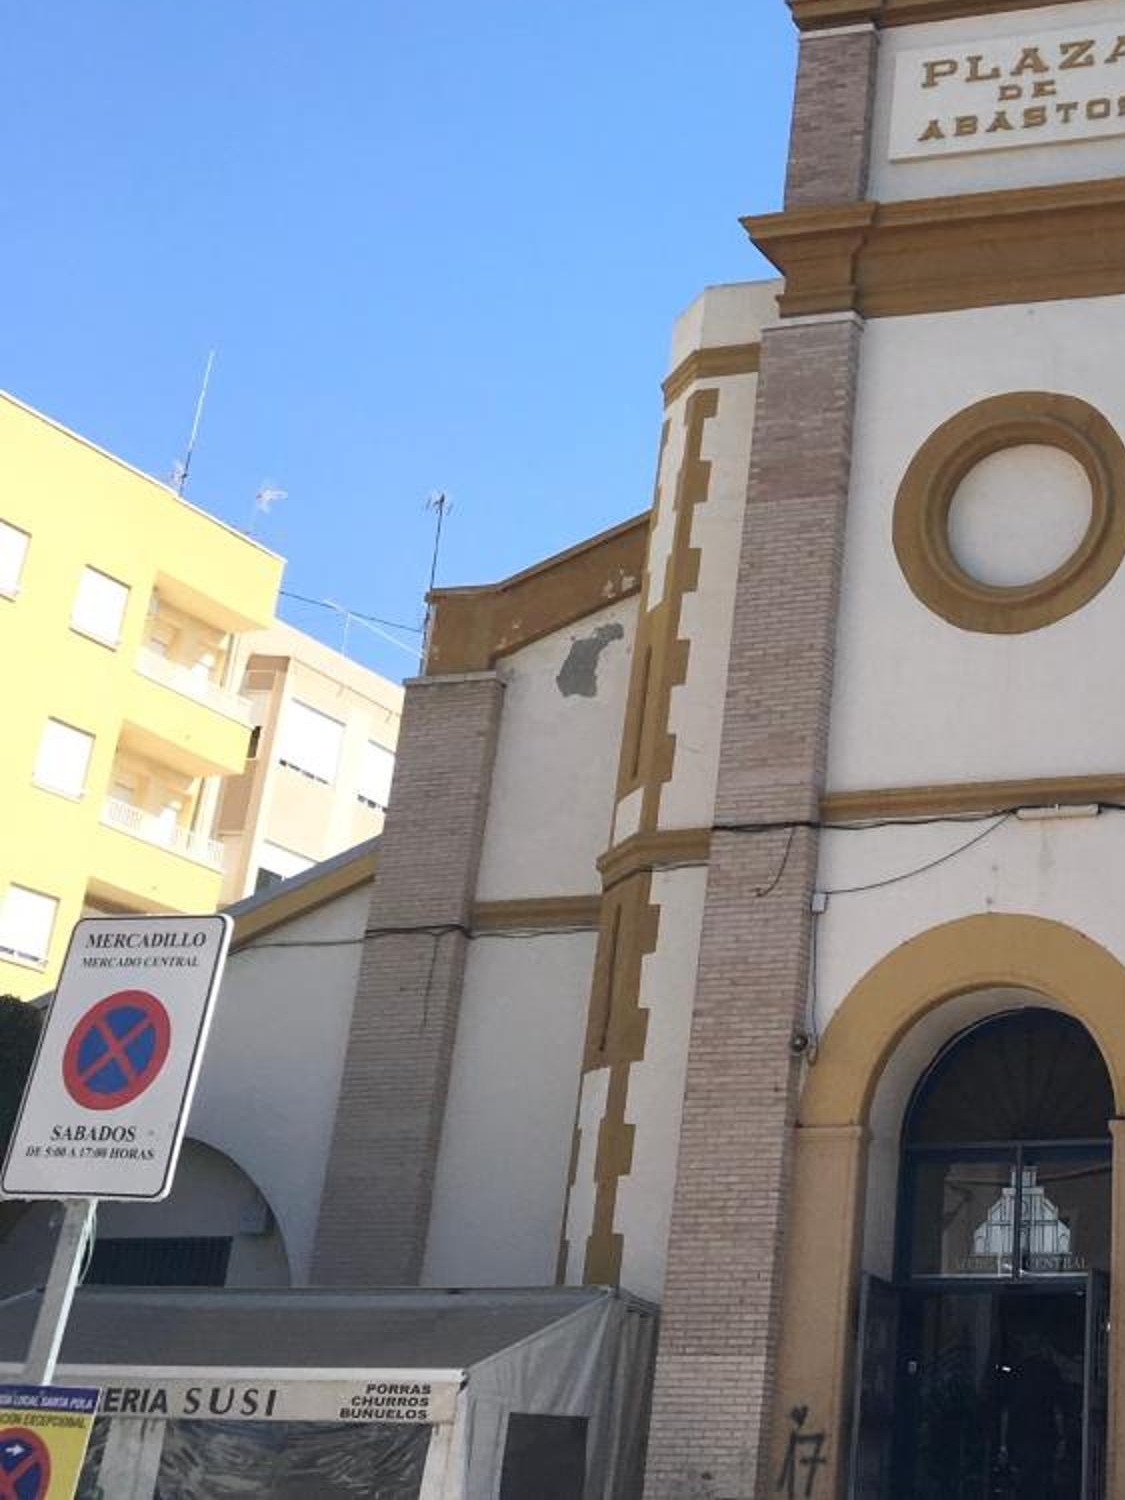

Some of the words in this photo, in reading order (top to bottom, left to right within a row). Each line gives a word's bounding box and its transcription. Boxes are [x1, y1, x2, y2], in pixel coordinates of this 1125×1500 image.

[998, 80, 1057, 101] DE
[86, 932, 206, 948] MERCADILLO
[82, 956, 142, 968] MERCADO
[143, 956, 199, 967] CENTRAL
[50, 1125, 136, 1141] SABADOS
[26, 1146, 40, 1157] DE
[109, 1148, 155, 1159] HORAS
[366, 1384, 431, 1394] PORRAS
[98, 1387, 168, 1413] ERIA
[183, 1387, 276, 1416] SUSI
[352, 1396, 429, 1407] CHURROS
